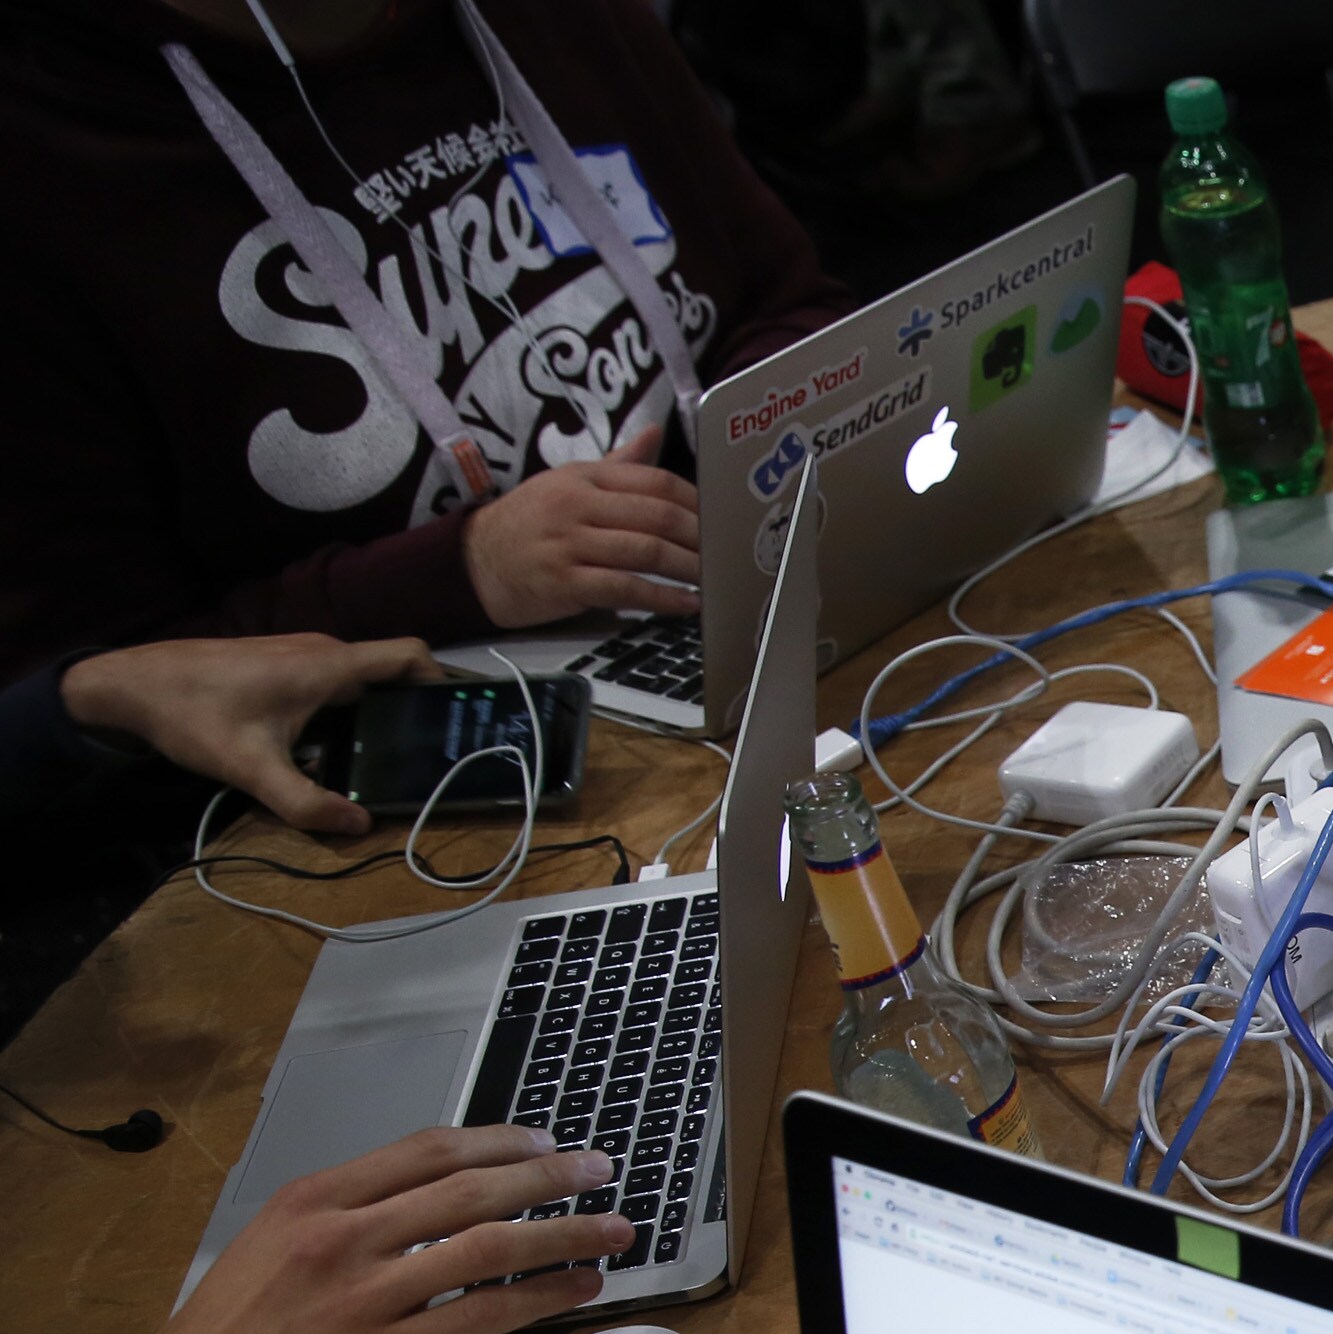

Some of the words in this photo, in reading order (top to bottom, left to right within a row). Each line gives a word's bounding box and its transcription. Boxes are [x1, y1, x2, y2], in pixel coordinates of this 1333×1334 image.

[940, 228, 1093, 329] Sparkcentral
[729, 391, 807, 441] Engine
[812, 358, 863, 394] Yard
[812, 374, 927, 457] SendGrid
[566, 968, 577, 976] W
[1286, 936, 1303, 964] OM
[585, 1047, 596, 1055] G
